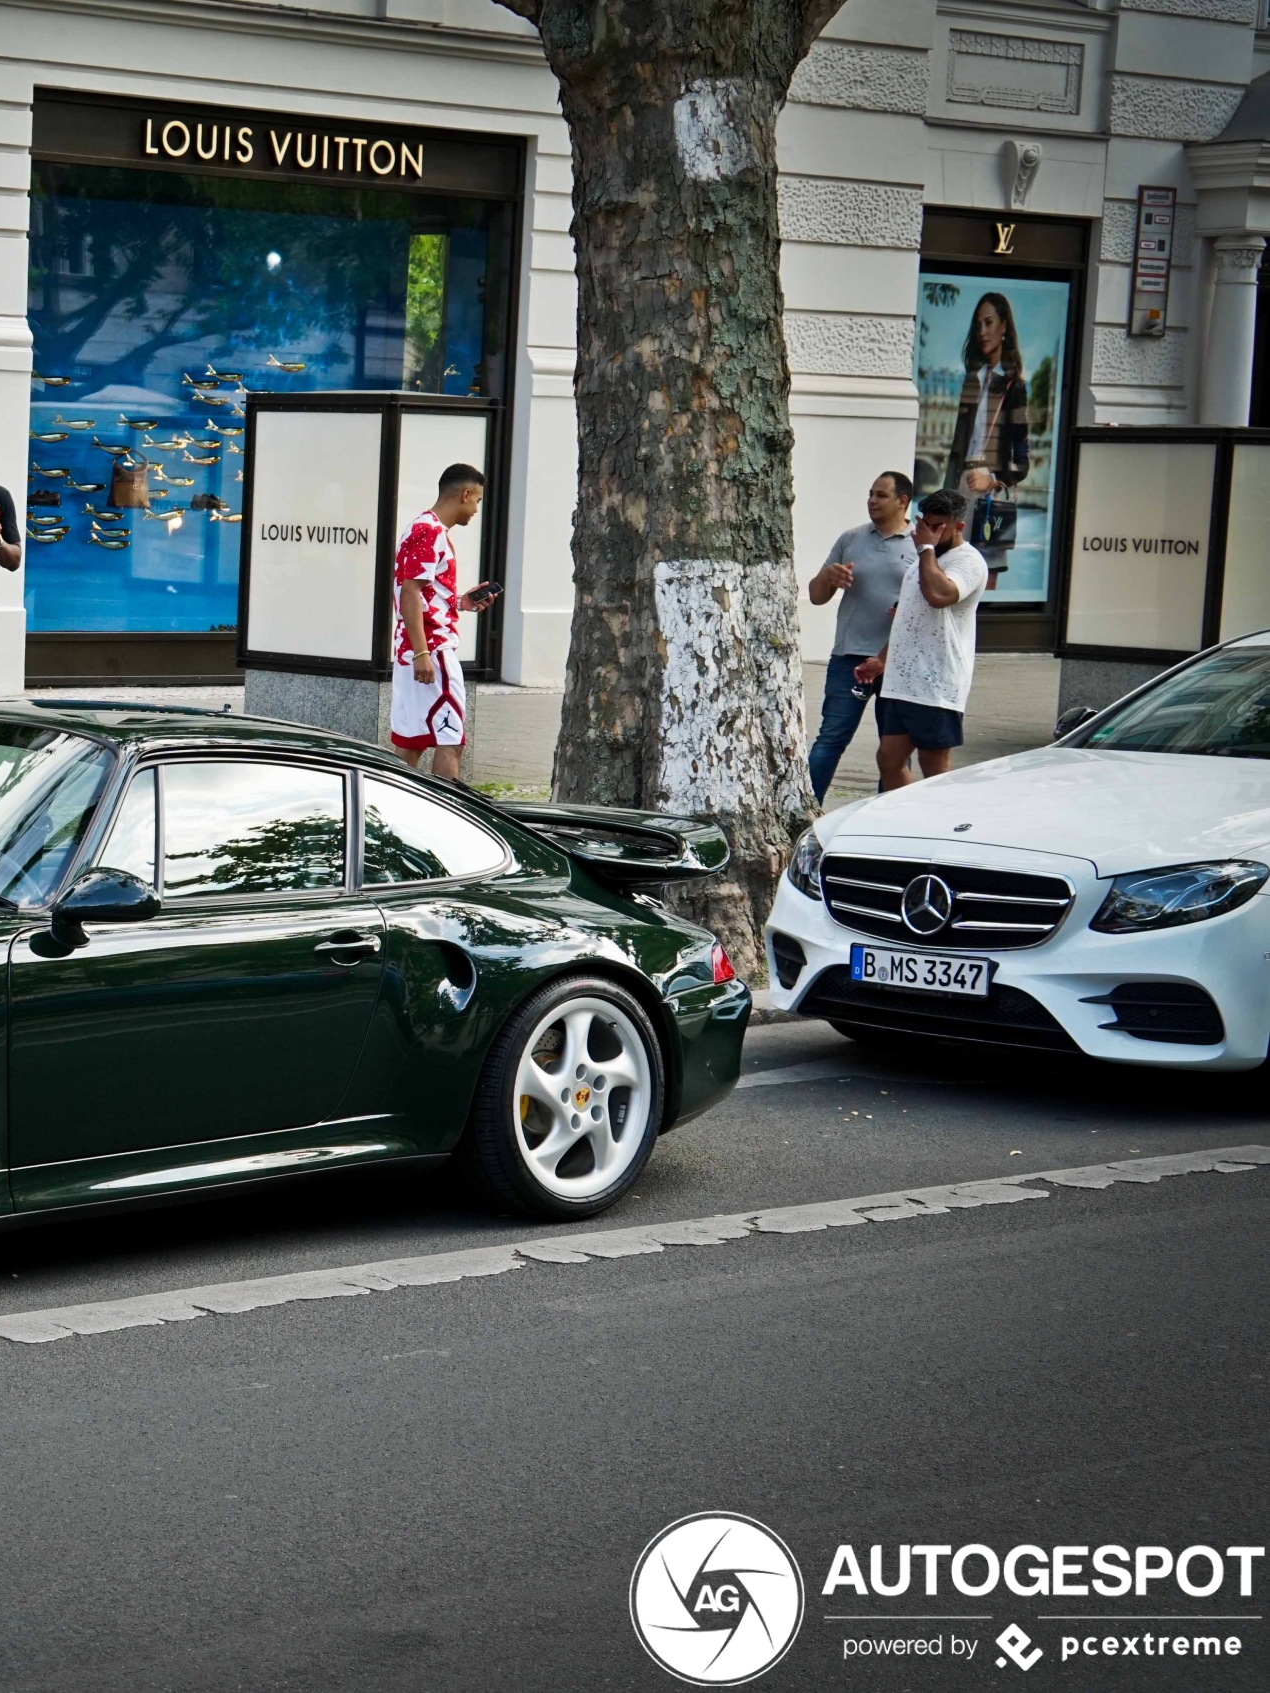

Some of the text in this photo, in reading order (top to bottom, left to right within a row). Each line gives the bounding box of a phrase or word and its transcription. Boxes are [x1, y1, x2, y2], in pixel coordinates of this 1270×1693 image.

[145, 118, 424, 178] LOUIS VUITTON
[261, 523, 369, 545] LOUIS VUITTON
[1083, 537, 1199, 555] LOUIS VUITTON
[864, 952, 983, 990] B MS 3347
